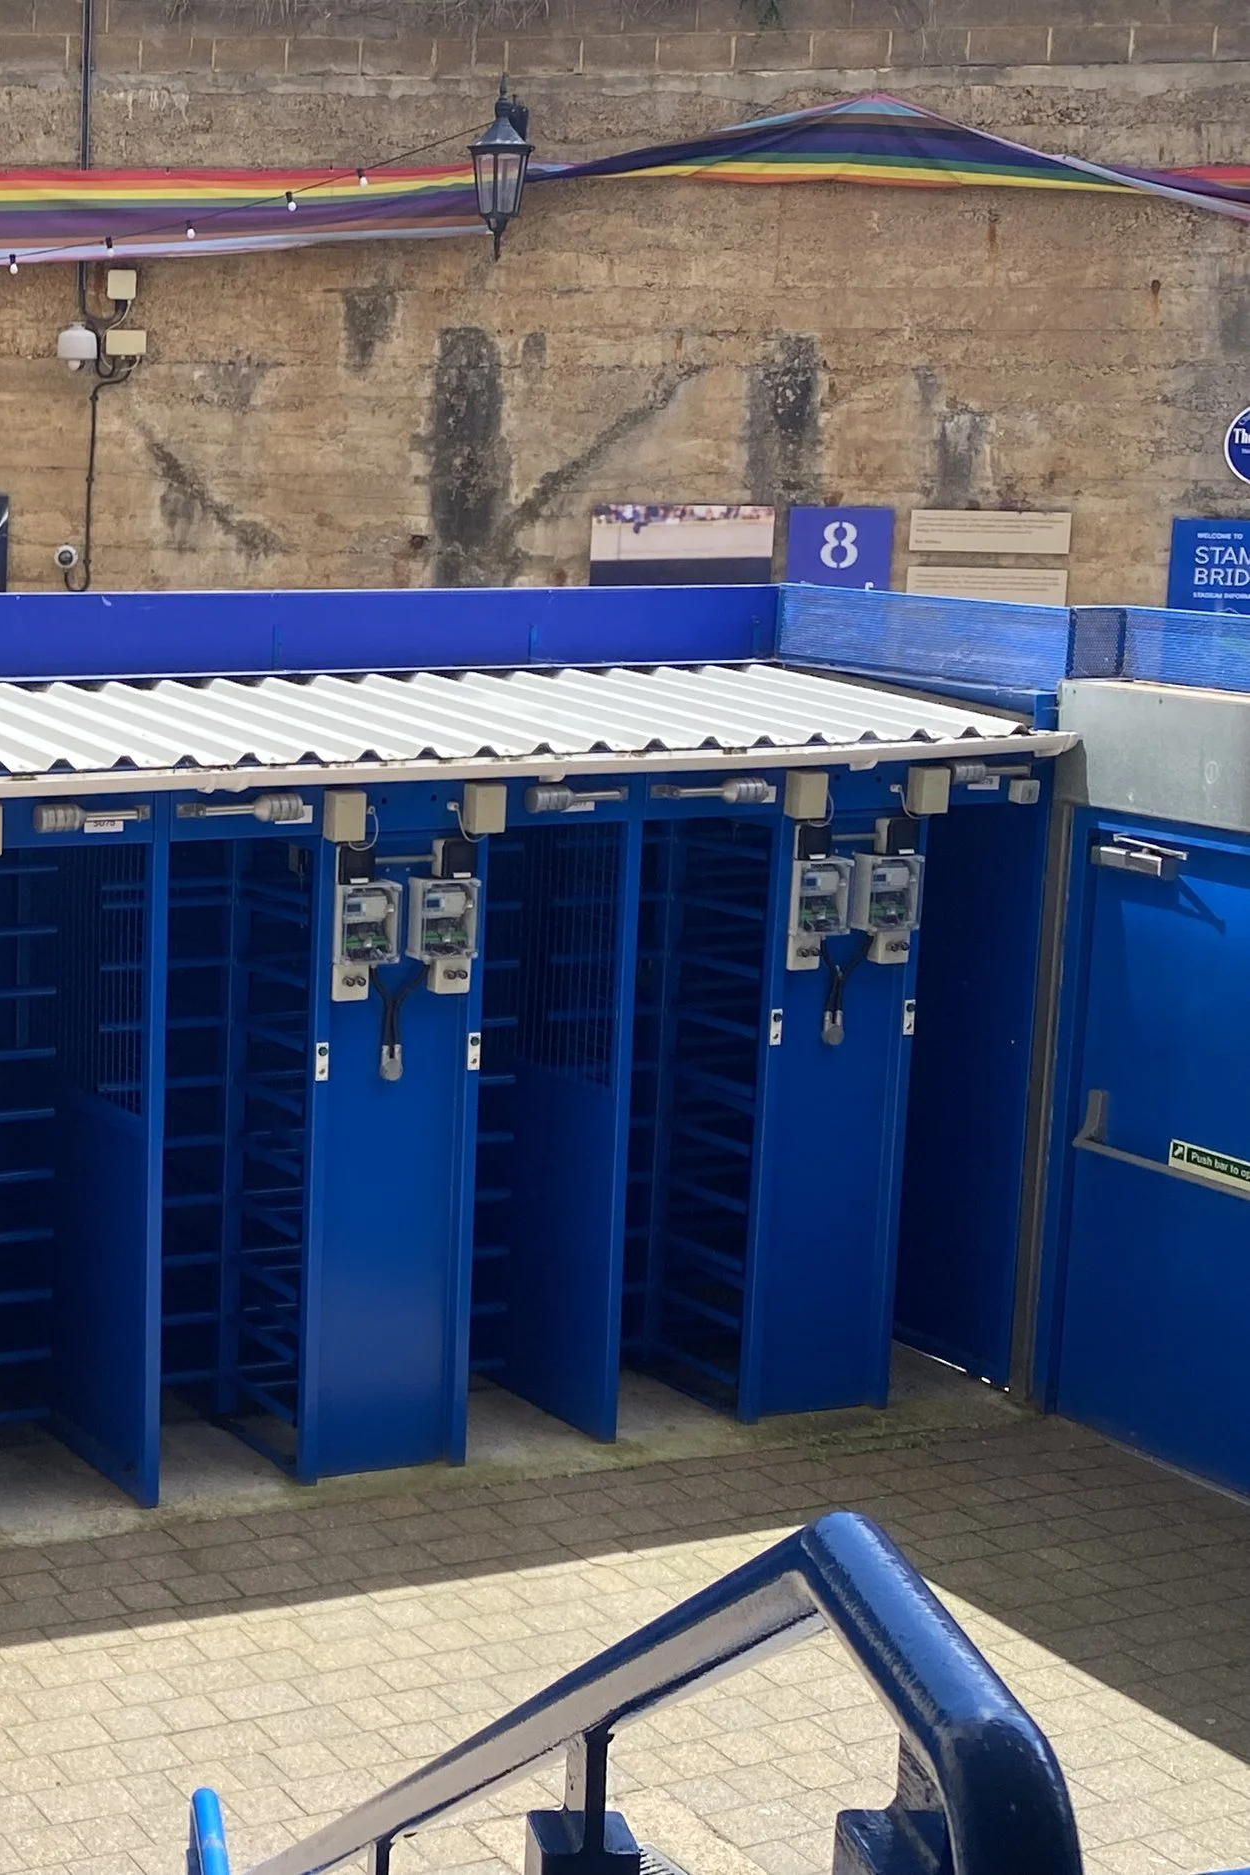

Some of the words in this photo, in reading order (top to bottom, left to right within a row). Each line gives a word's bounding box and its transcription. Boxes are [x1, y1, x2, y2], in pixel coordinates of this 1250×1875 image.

[820, 521, 858, 569] 8
[1197, 532, 1231, 540] WELCOME
[1193, 567, 1250, 586] BRID
[1191, 1151, 1213, 1167] Push
[1214, 1159, 1229, 1171] bar
[1230, 1164, 1240, 1176] to
